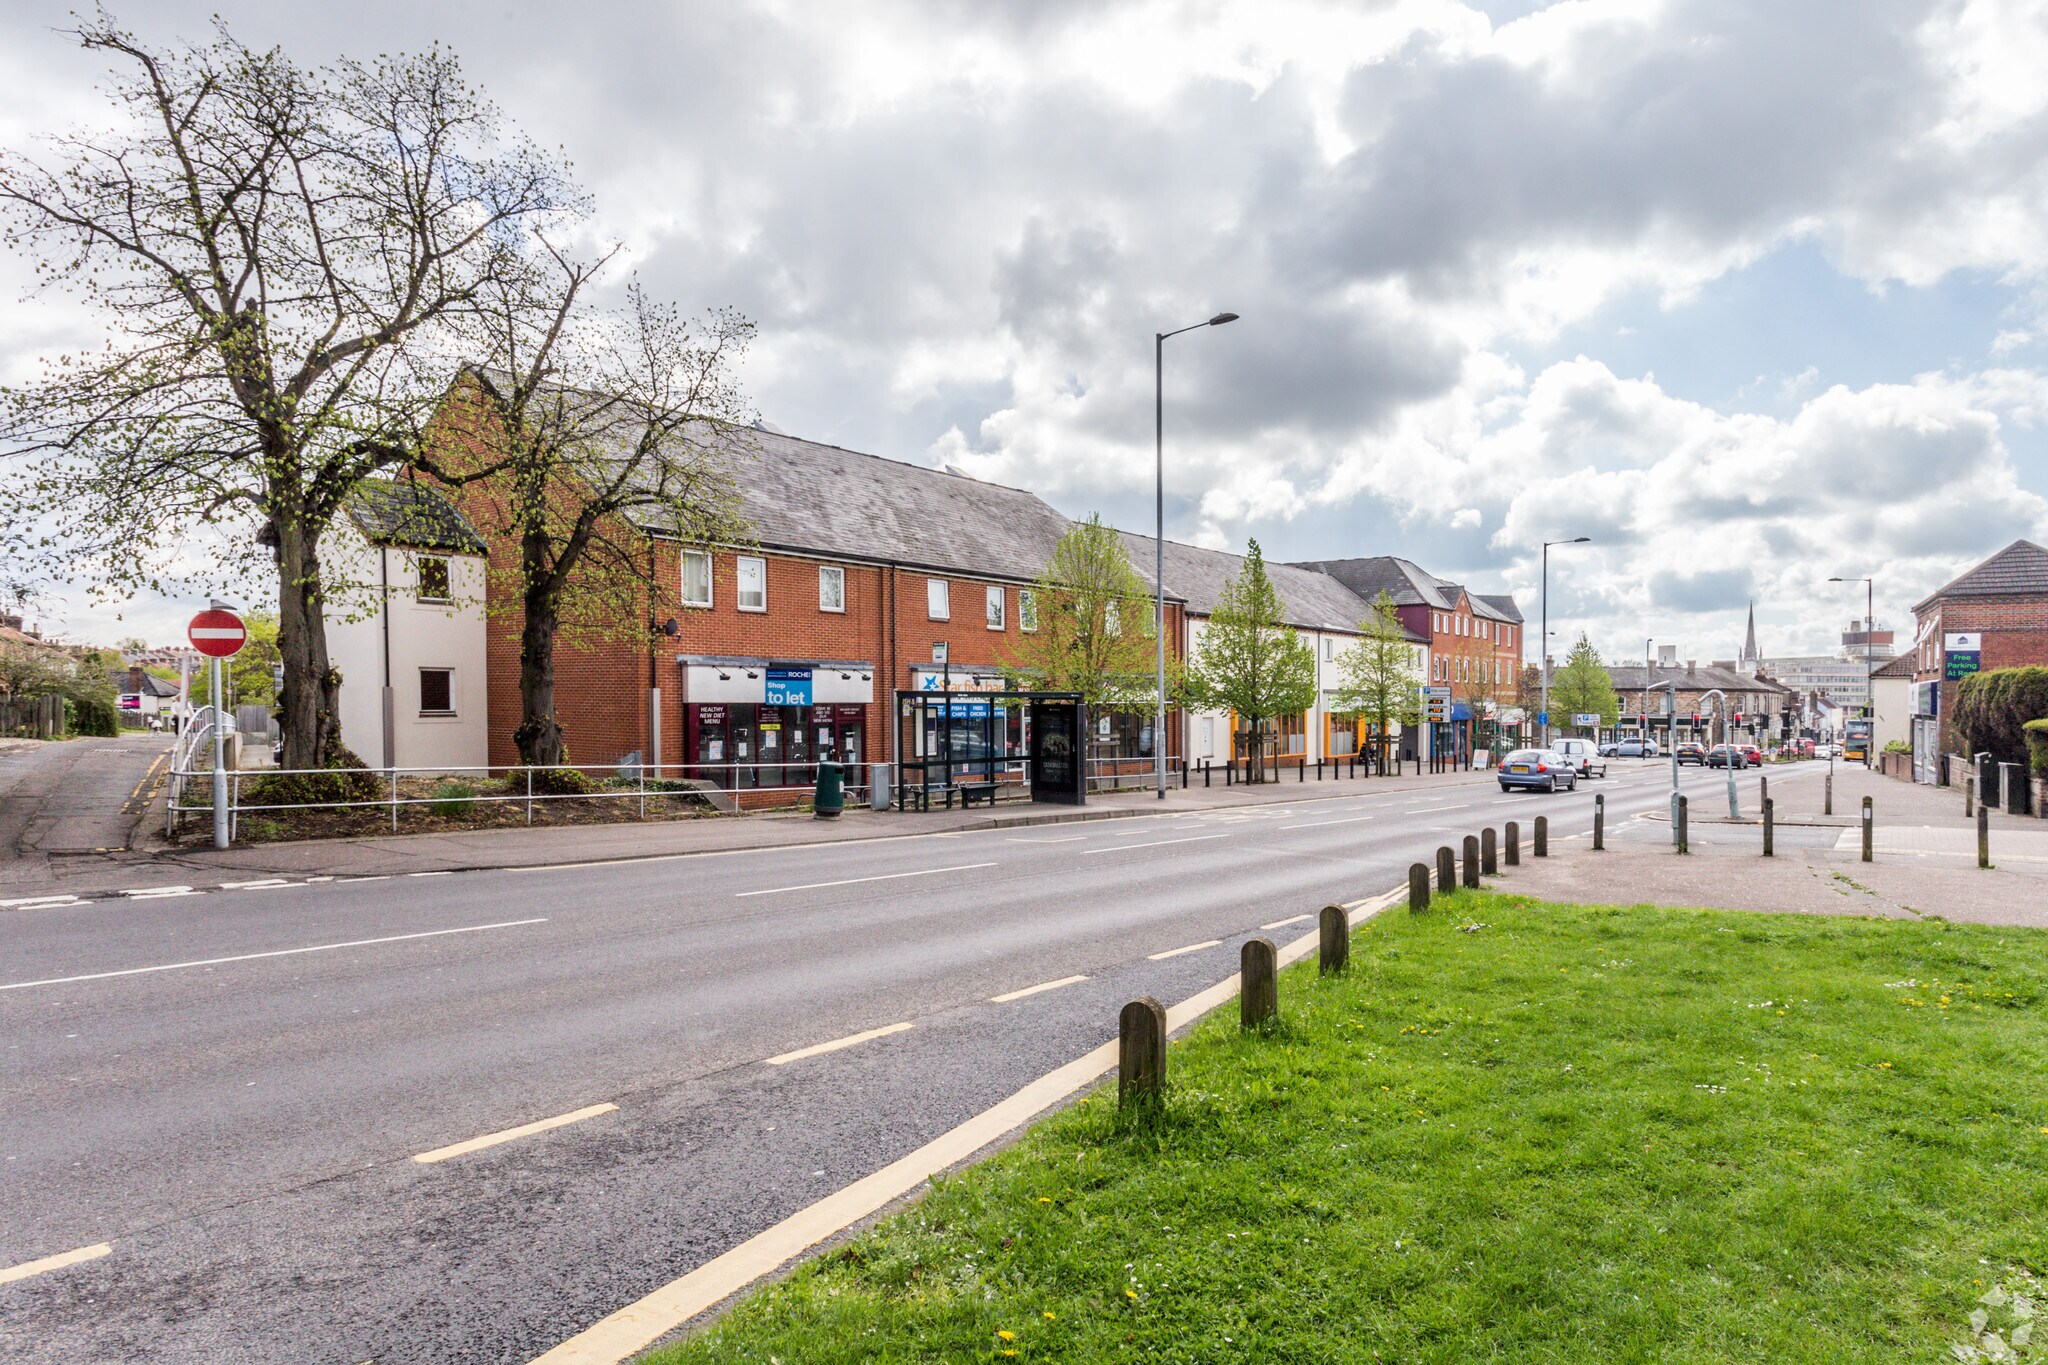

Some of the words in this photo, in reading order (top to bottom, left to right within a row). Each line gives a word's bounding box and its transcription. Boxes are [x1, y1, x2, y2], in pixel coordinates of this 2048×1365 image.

[1947, 662, 1977, 670] Parking
[767, 681, 786, 690] Shop
[983, 680, 1003, 691] bar
[767, 691, 784, 704] to
[786, 690, 805, 705] let
